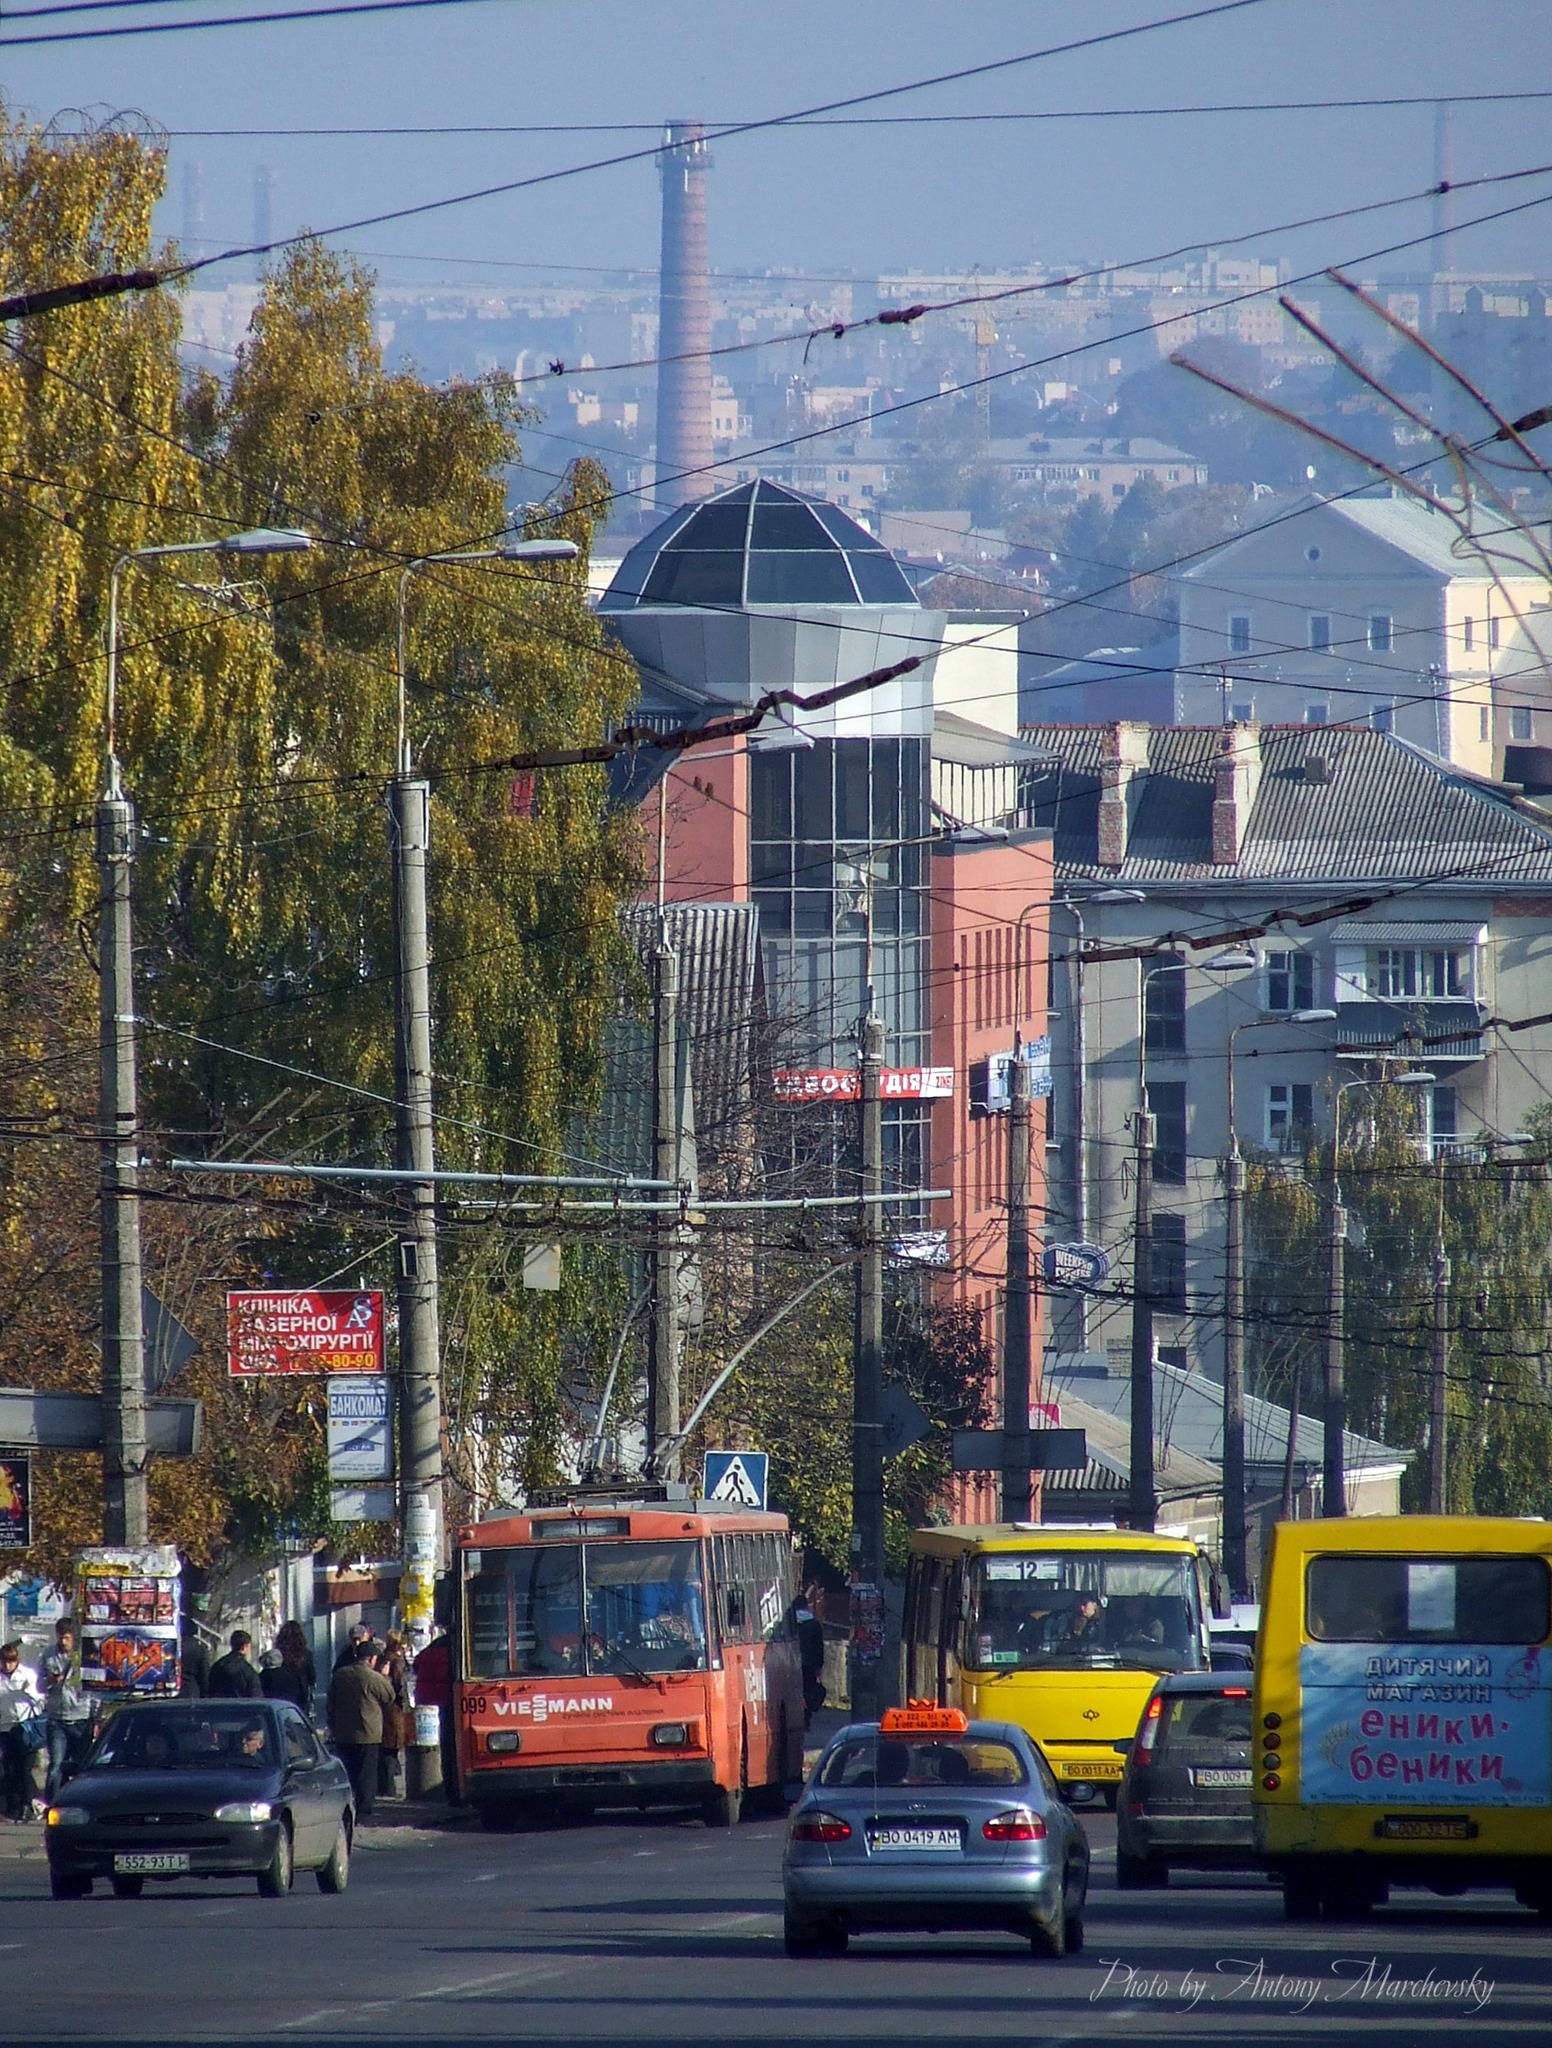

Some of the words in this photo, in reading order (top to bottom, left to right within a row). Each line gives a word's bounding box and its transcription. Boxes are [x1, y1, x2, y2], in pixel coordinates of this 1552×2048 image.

[238, 1298, 313, 1314] КЛІНІКА
[1016, 1561, 1037, 1579] 12
[1366, 1656, 1492, 1679] ДИТЯЧИЙ
[1366, 1684, 1493, 1704] МАГАЗИН
[494, 1694, 613, 1722] VIESSMANN
[1350, 1745, 1505, 1787] беники
[1204, 1772, 1220, 1782] BO
[881, 1831, 900, 1844] BO
[903, 1831, 934, 1844] 0419
[938, 1831, 957, 1844] AM
